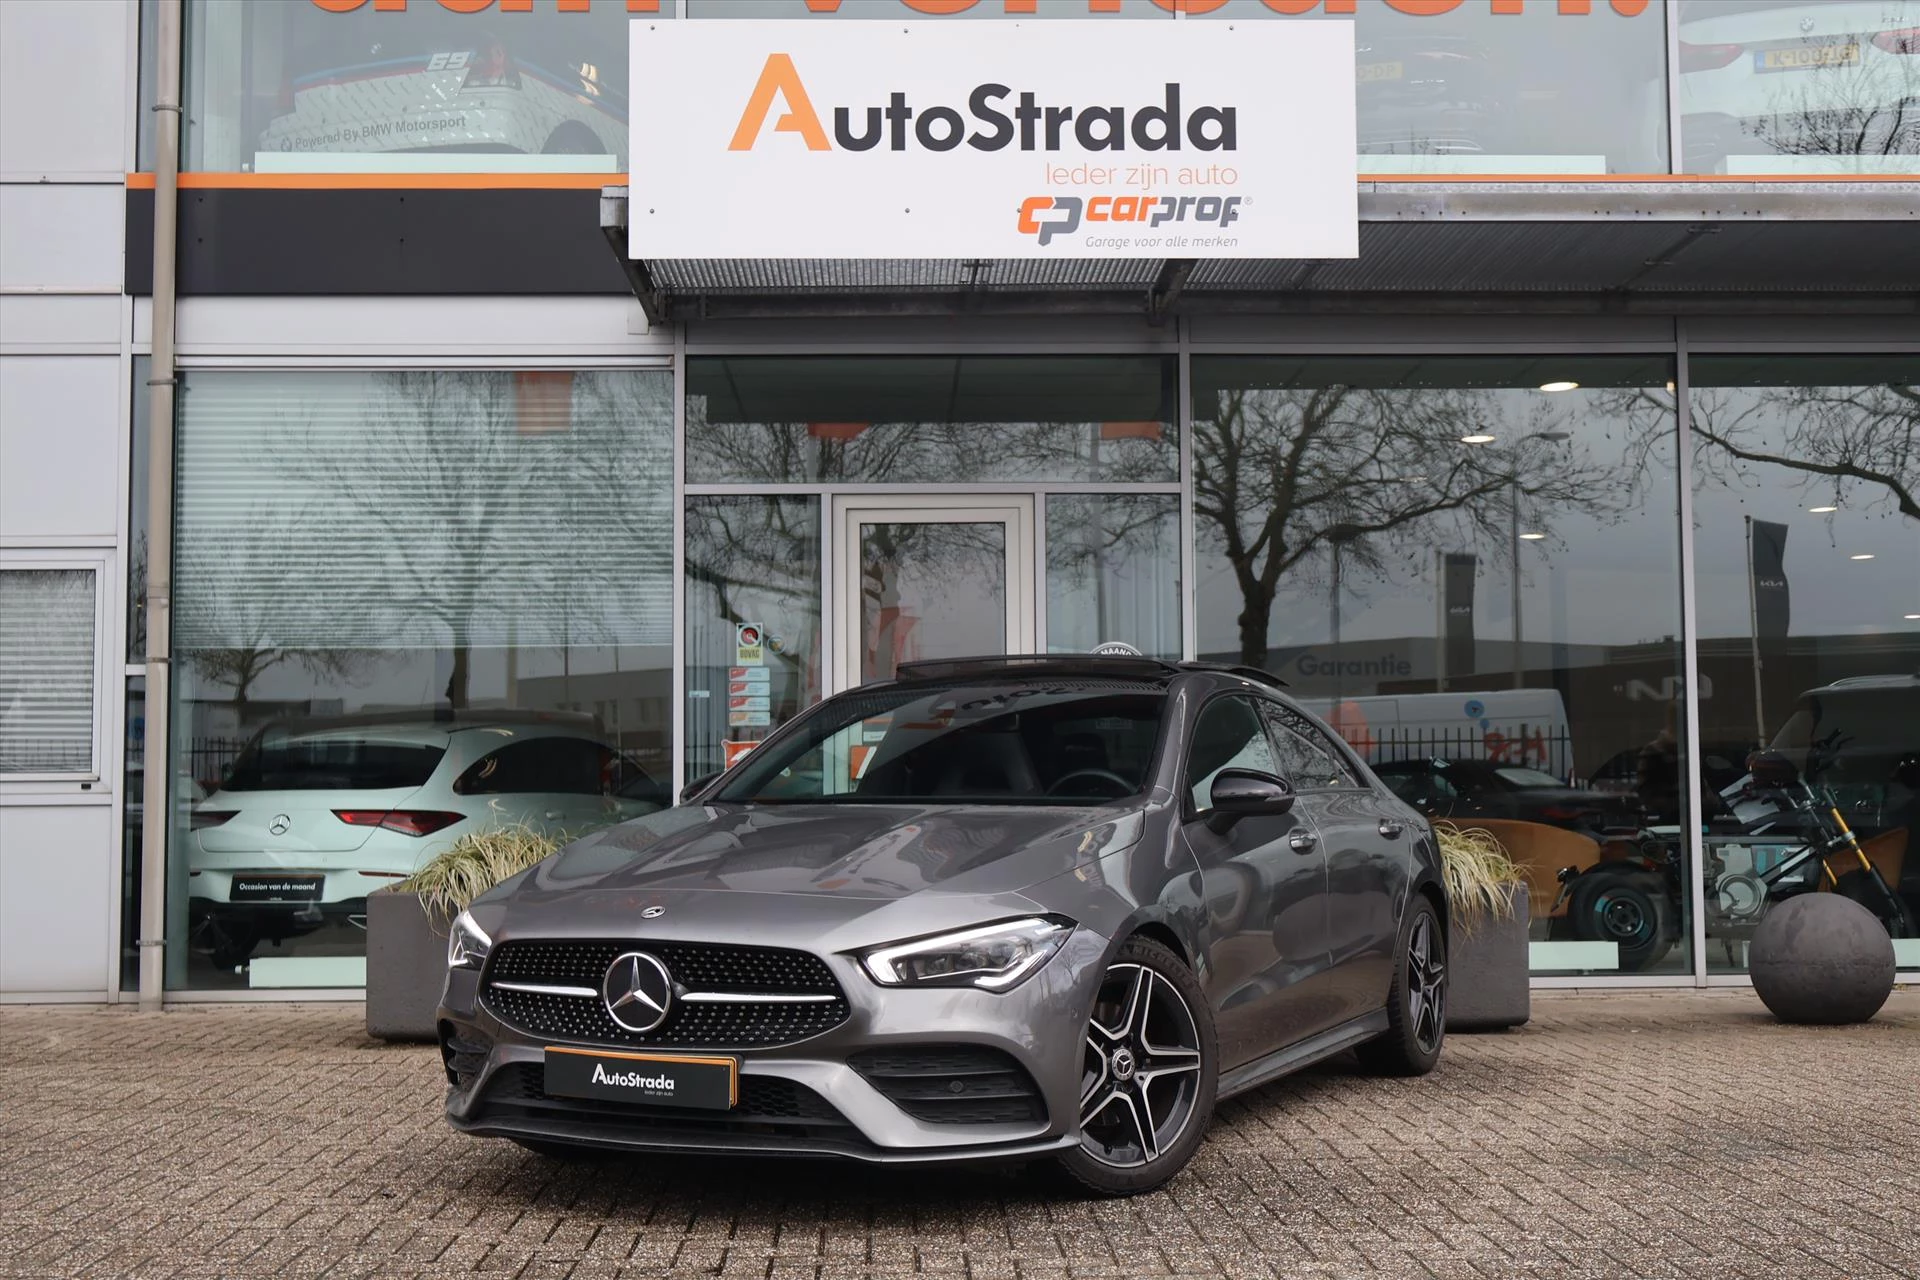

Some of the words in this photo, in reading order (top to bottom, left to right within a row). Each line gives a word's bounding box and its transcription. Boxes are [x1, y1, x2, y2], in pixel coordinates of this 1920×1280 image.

[427, 51, 470, 71] 69
[727, 53, 1237, 152] AutoStrada
[295, 130, 341, 149] Powered
[343, 128, 358, 142] By
[362, 123, 392, 138] BMW
[395, 115, 466, 133] Motorsport
[1046, 162, 1117, 185] Ieder
[1126, 163, 1169, 190] zijn
[1178, 164, 1238, 185] auto
[1085, 236, 1130, 250] Garage
[1134, 238, 1163, 248] voor
[1166, 236, 1188, 248] alle
[1191, 236, 1238, 248] merken
[1297, 652, 1412, 676] Garantie
[239, 882, 267, 891] Occasion
[282, 882, 290, 891] de
[291, 882, 316, 891] maand
[591, 1063, 675, 1090] AutoStrada
